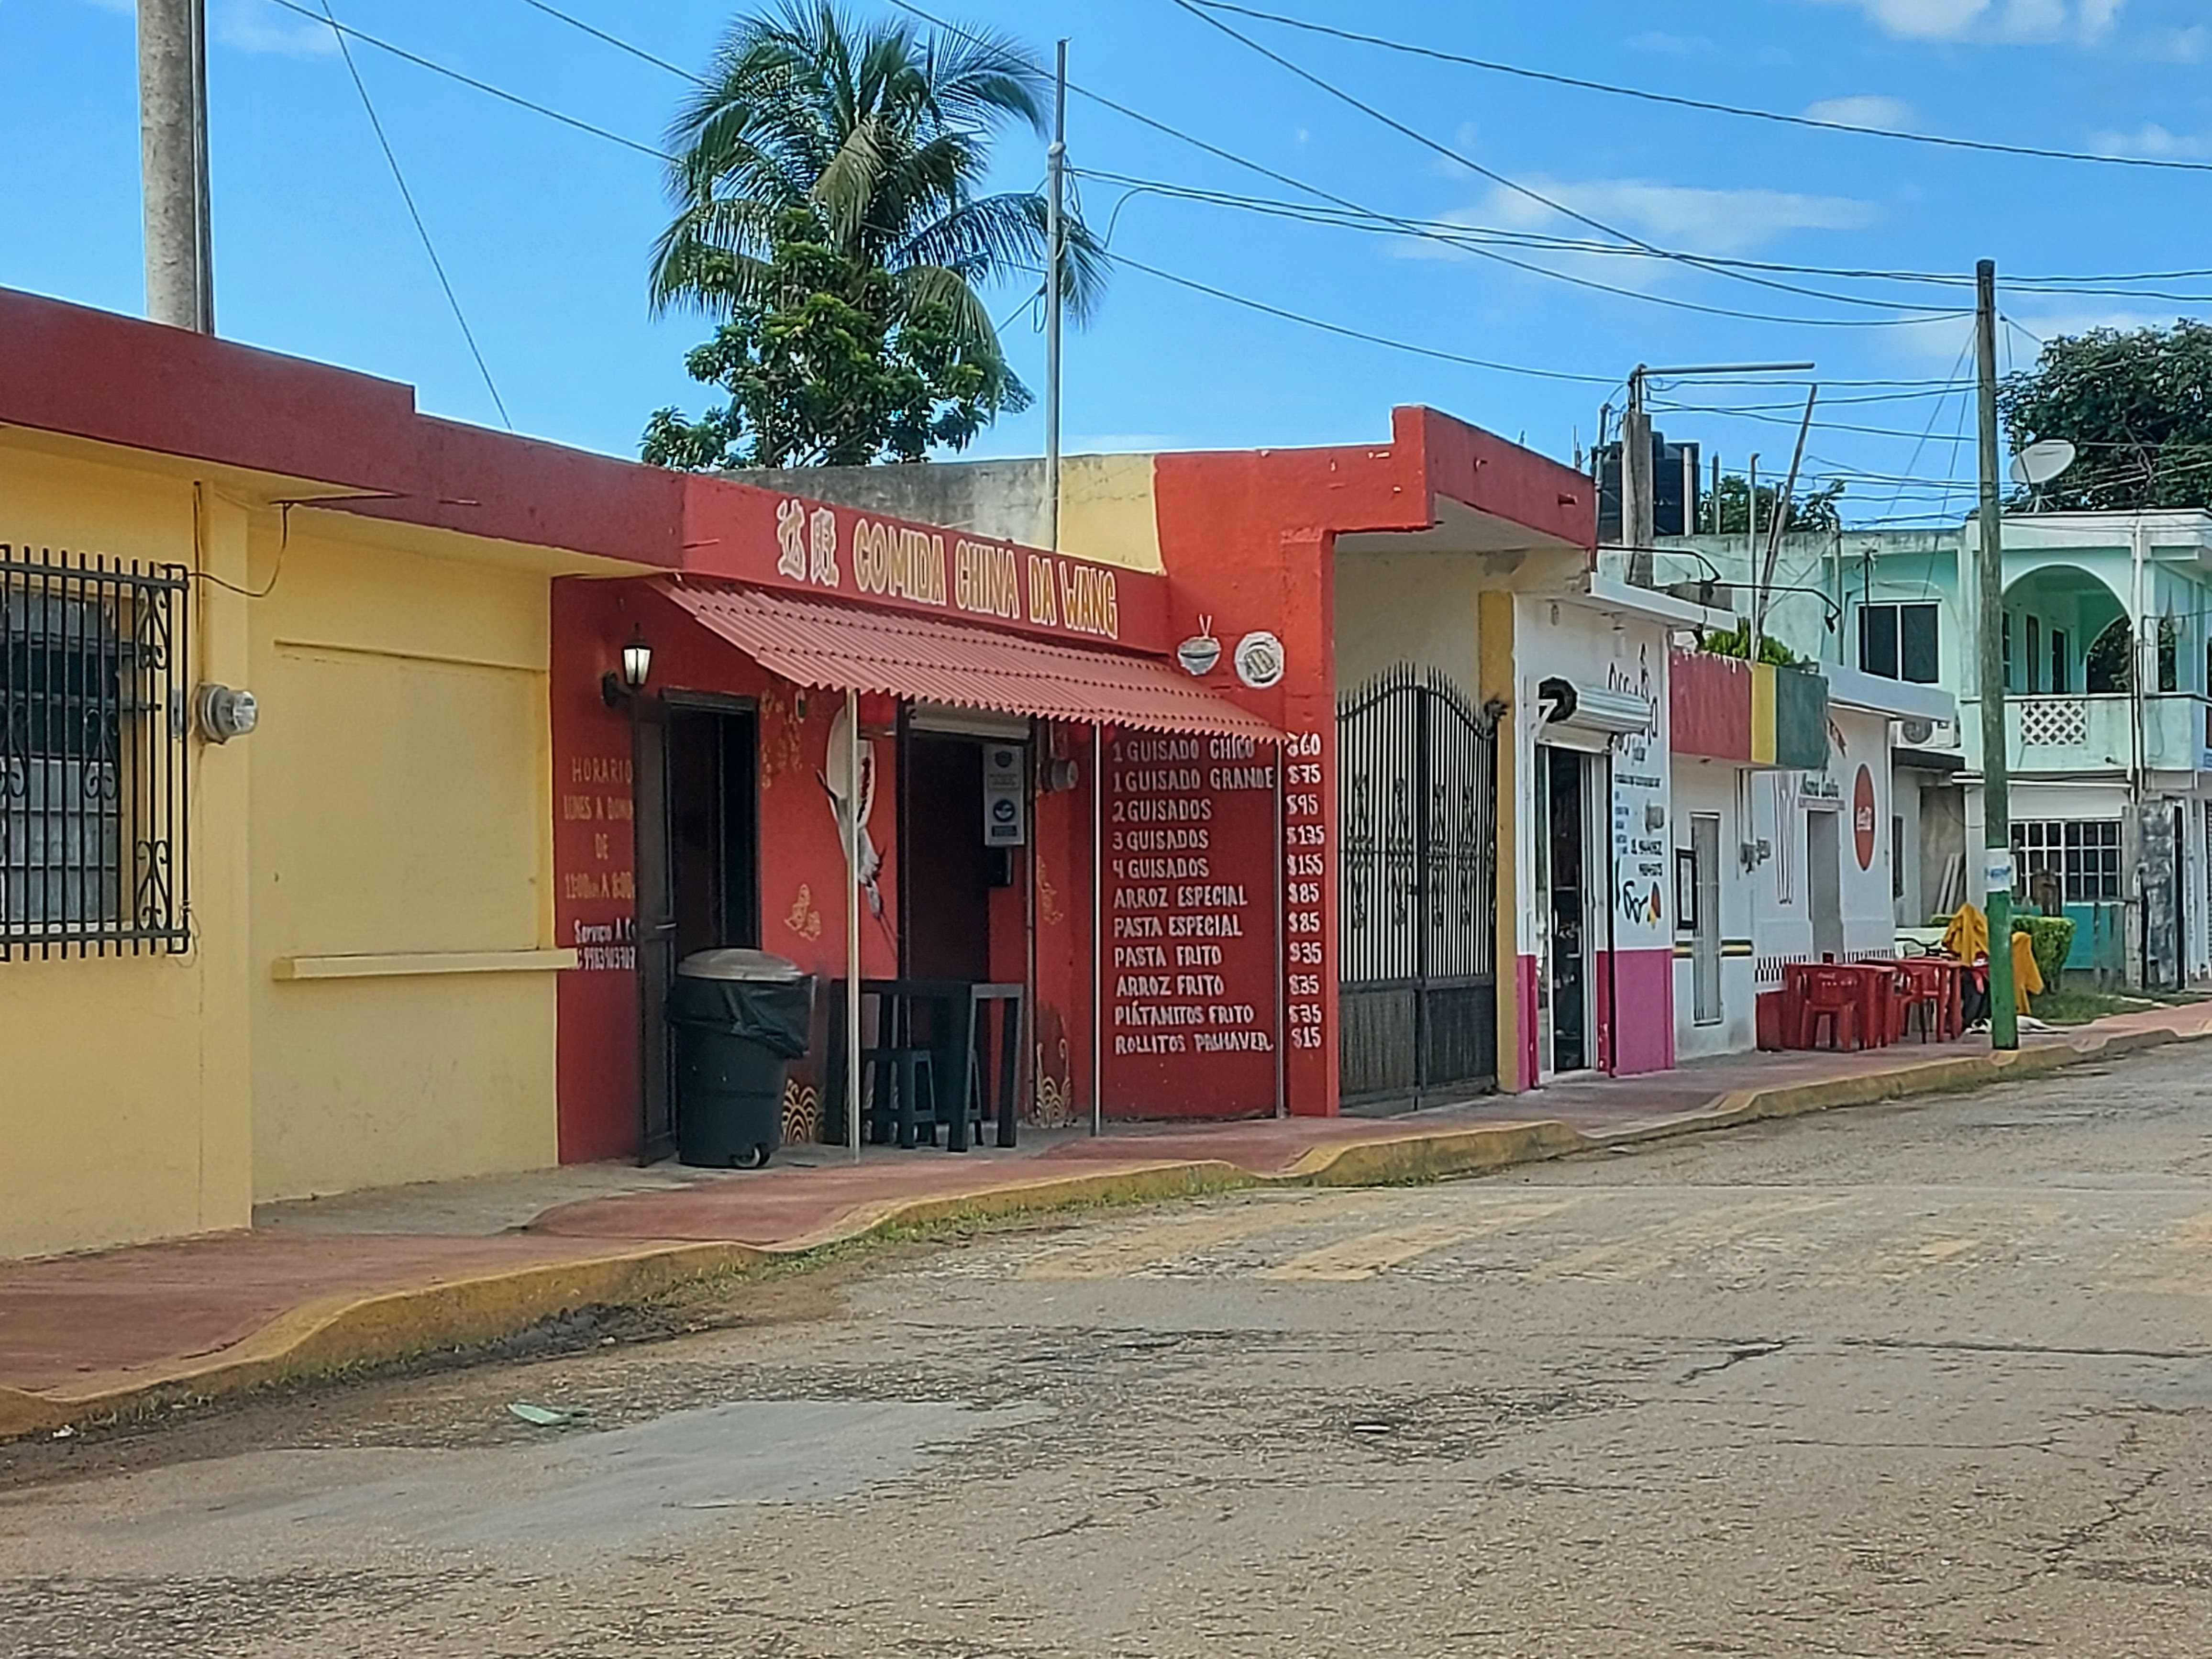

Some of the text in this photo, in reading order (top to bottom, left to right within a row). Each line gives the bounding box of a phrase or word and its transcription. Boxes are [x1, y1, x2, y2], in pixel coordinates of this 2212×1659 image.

[853, 518, 1118, 640] COMIDA CHINA DA WANG
[1113, 737, 1254, 762] 1 GUISADO CHICO
[572, 757, 633, 784] HORARIO
[1113, 766, 1274, 792] 1 GUISADO GRANDE
[1287, 763, 1321, 785] $75
[596, 796, 604, 820] A
[1112, 798, 1212, 822] 2 GUISADOS
[1286, 794, 1318, 815] $95
[1112, 828, 1209, 851] 3 GUISADOS
[1286, 824, 1325, 845] $135
[595, 833, 608, 860] DE
[1112, 857, 1209, 879] 4 GUISADOS
[1287, 853, 1324, 876] $155
[1114, 884, 1248, 909] ARROZ ESPECIAL
[1288, 882, 1319, 904] $85
[1113, 914, 1243, 938] PASTA ESPECIAL
[1288, 912, 1320, 933] $85
[1114, 945, 1223, 968] PASTA FRITO
[1289, 941, 1322, 964] $35
[1116, 975, 1225, 997] ARROZ FRITO
[1288, 975, 1320, 995] $35
[1208, 1004, 1254, 1024] FRITO
[1289, 1005, 1322, 1024] $35
[1115, 1034, 1186, 1055] ROLLITOS
[1291, 1027, 1322, 1049] $15
